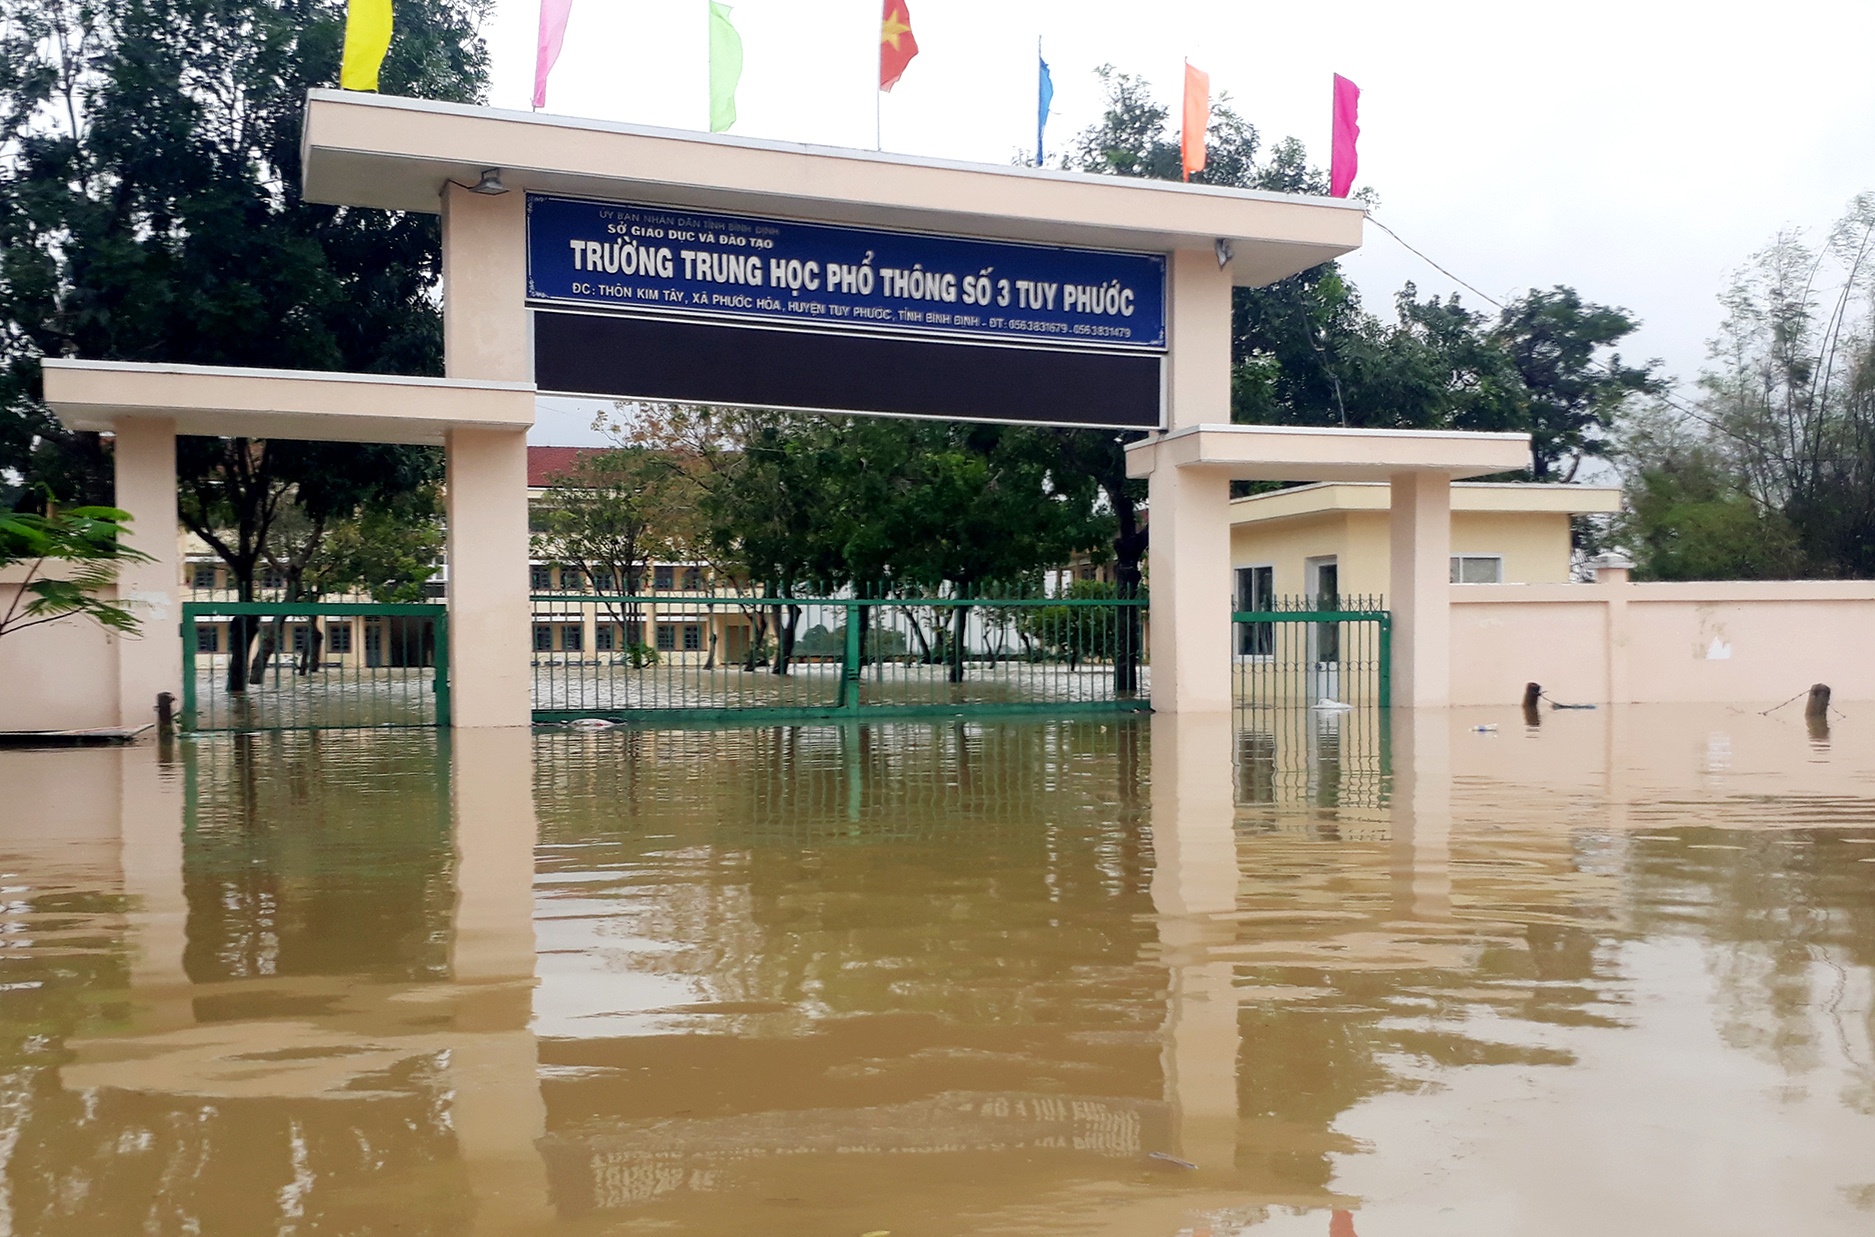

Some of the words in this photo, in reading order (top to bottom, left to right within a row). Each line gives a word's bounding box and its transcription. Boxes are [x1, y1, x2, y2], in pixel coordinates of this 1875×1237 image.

[607, 221, 627, 235] SỞ
[631, 225, 664, 239] GIÁO
[668, 230, 695, 243] DỤC
[698, 231, 716, 244] VÀ
[719, 234, 746, 247] ĐÀO
[749, 237, 775, 250] TẠO
[617, 212, 640, 222] BAN
[677, 216, 700, 229] DÂN
[569, 235, 674, 279] TRƯỜNG
[680, 249, 763, 287] TRUNG
[769, 257, 821, 297] HỌC
[826, 249, 875, 296] PHỔ
[879, 262, 958, 303] THÔNG
[961, 266, 994, 306] SỐ
[996, 278, 1011, 307] 3
[1015, 279, 1059, 311] TUY
[1062, 279, 1135, 317] PHƯỚC
[572, 281, 596, 295] ĐC:
[598, 282, 632, 298] THÔN
[636, 288, 659, 300] KIM
[662, 287, 689, 304] TÂY,
[692, 291, 709, 305] XÃ
[712, 294, 753, 309] PHƯỚC
[787, 301, 826, 317] HUYỆN
[828, 304, 851, 316] TUY
